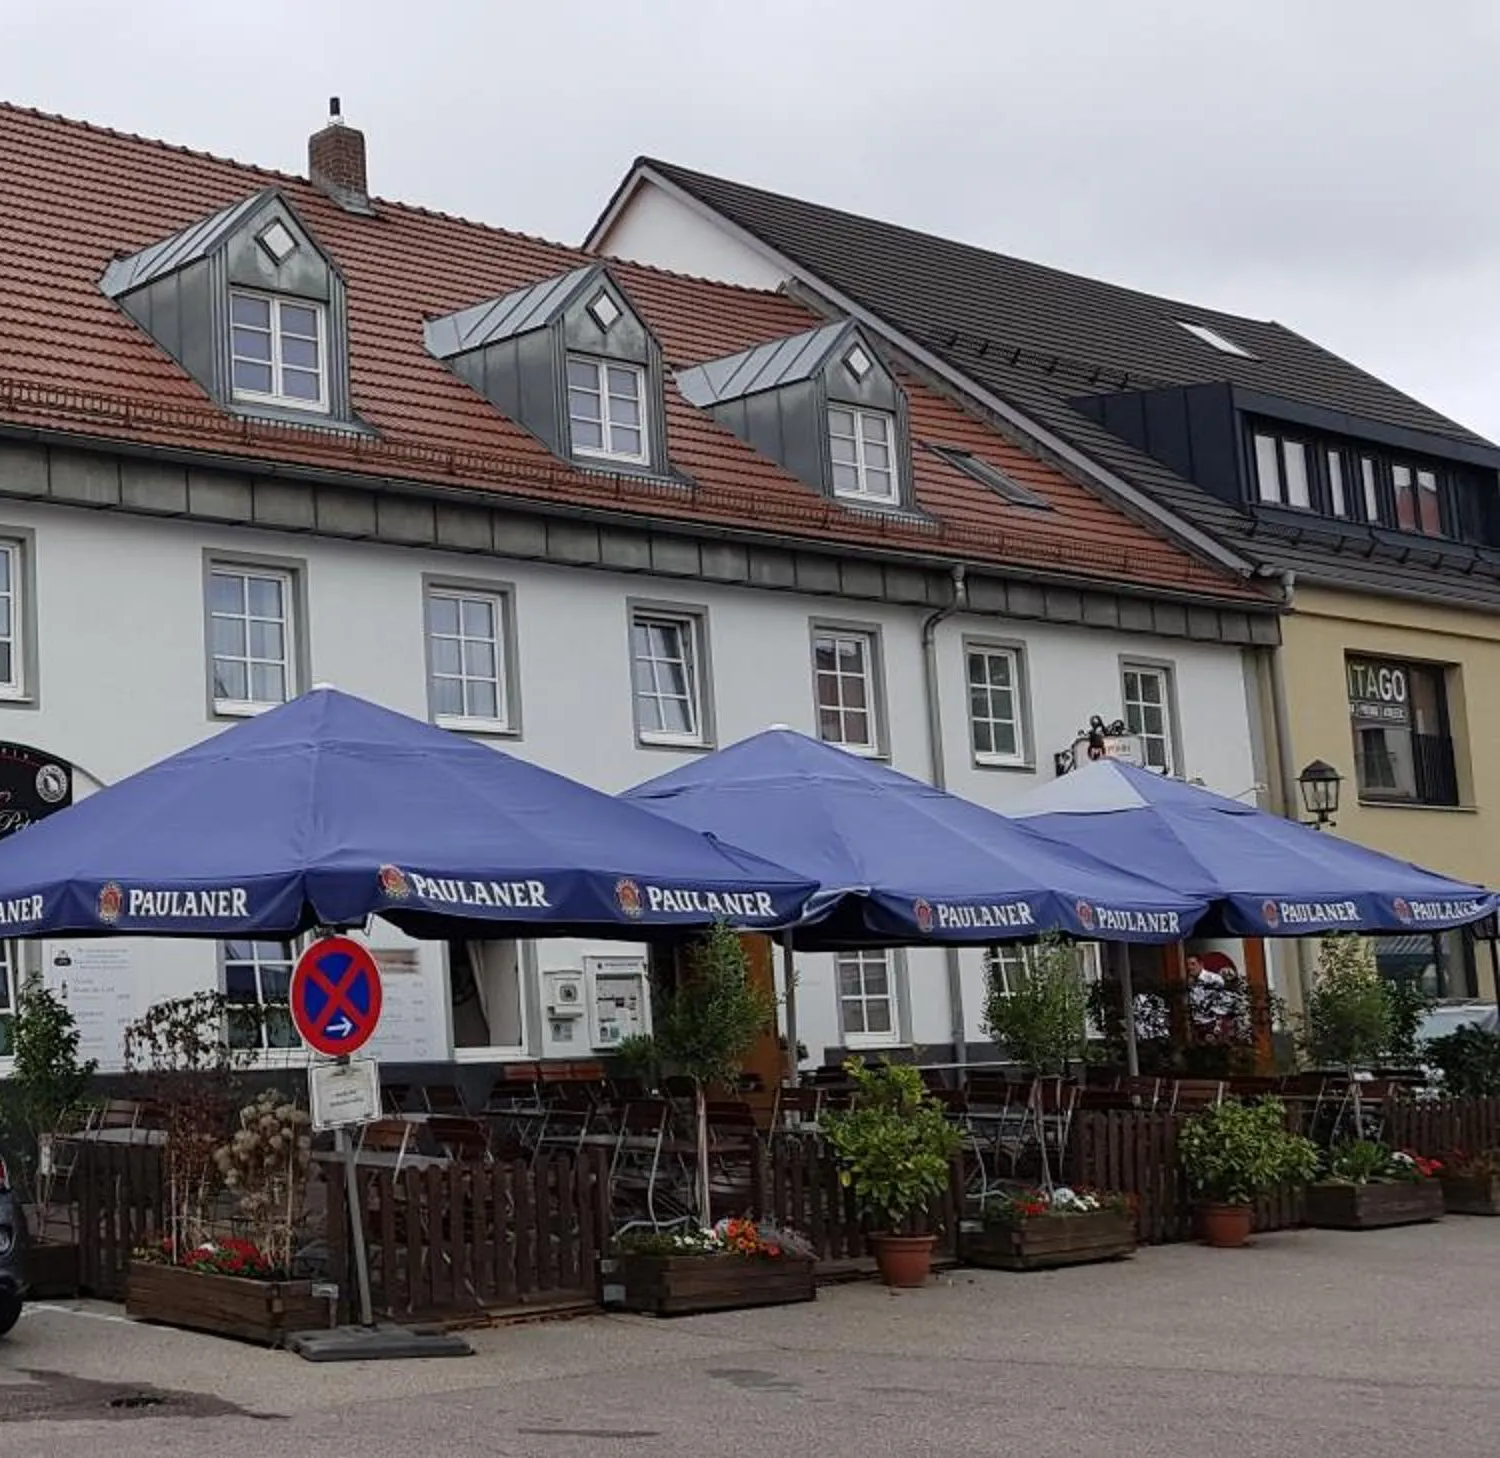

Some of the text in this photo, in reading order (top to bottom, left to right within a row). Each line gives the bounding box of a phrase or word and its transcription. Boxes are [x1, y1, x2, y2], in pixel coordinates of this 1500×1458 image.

[128, 887, 249, 917] PAULANER
[408, 872, 552, 908] PAULANER
[645, 886, 779, 917] PAULANER
[937, 902, 1035, 928] PAULANER
[1098, 907, 1180, 933] PAULANER
[1281, 901, 1362, 922] PAULANER
